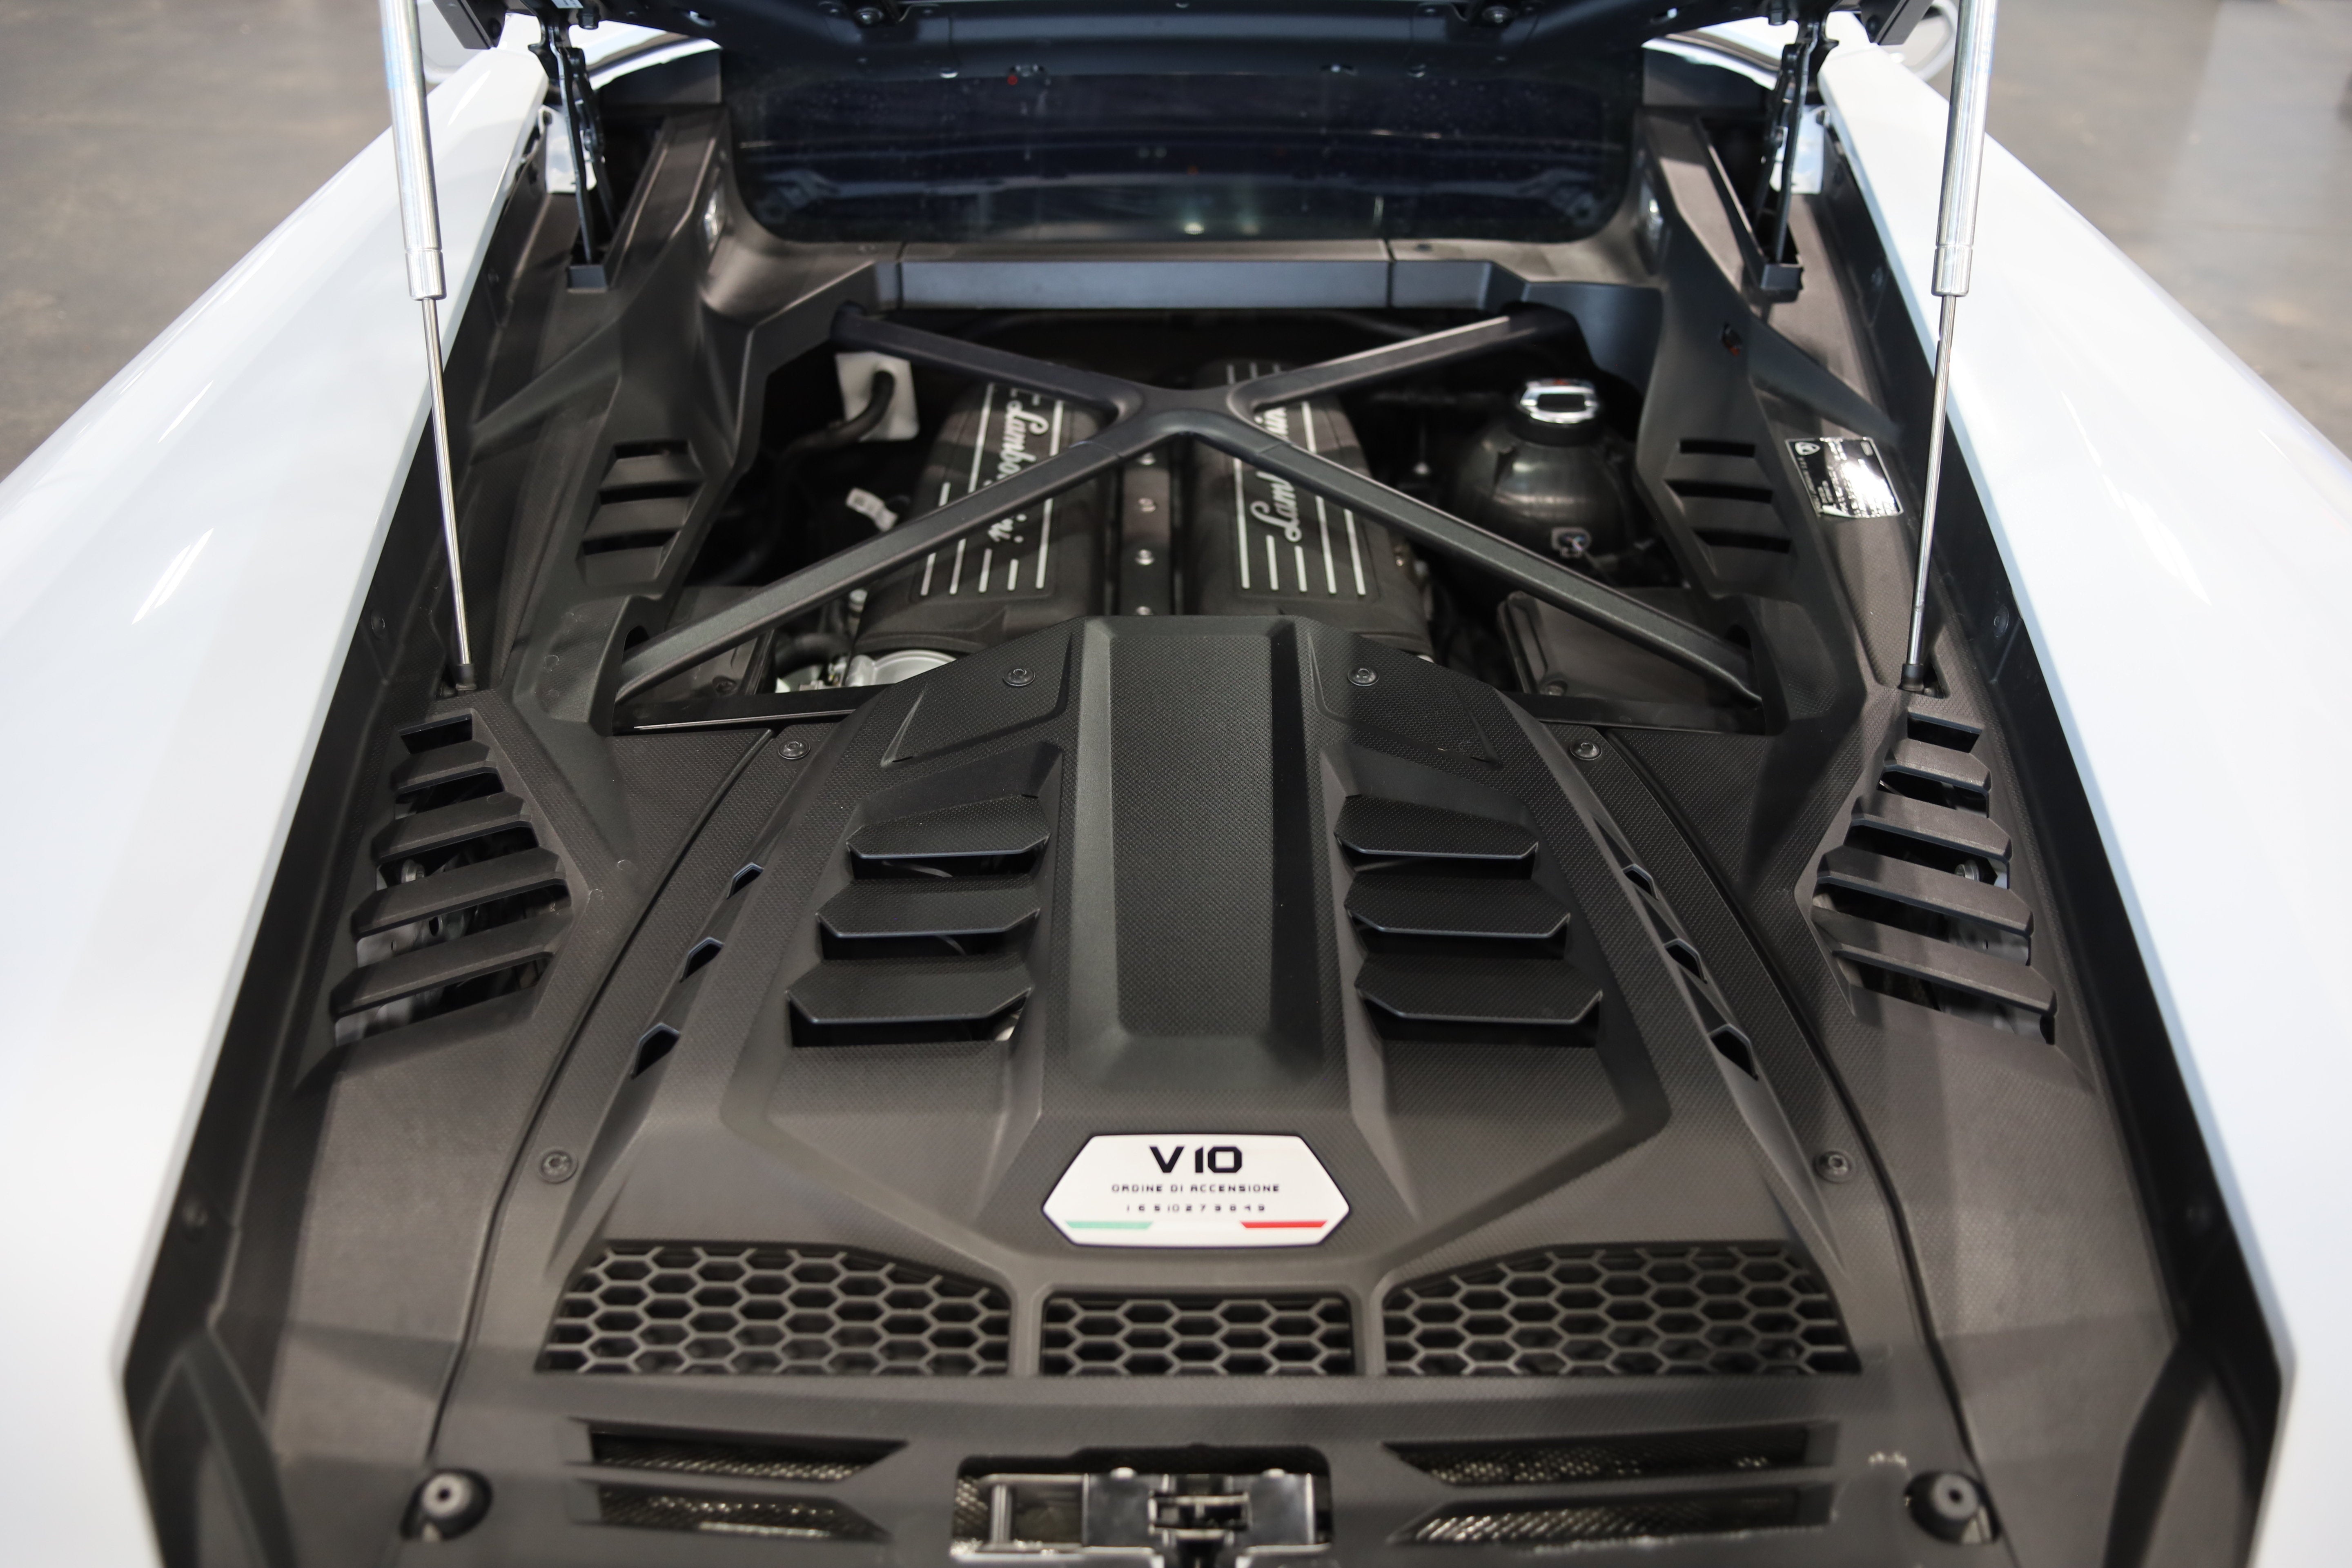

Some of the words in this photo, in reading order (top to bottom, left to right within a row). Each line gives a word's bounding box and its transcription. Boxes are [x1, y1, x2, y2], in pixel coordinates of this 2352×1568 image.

[1149, 1146, 1242, 1173] V10
[1111, 1184, 1163, 1192] ORDINE
[1170, 1184, 1183, 1192] DI
[1190, 1184, 1280, 1192] ACCENSIONE
